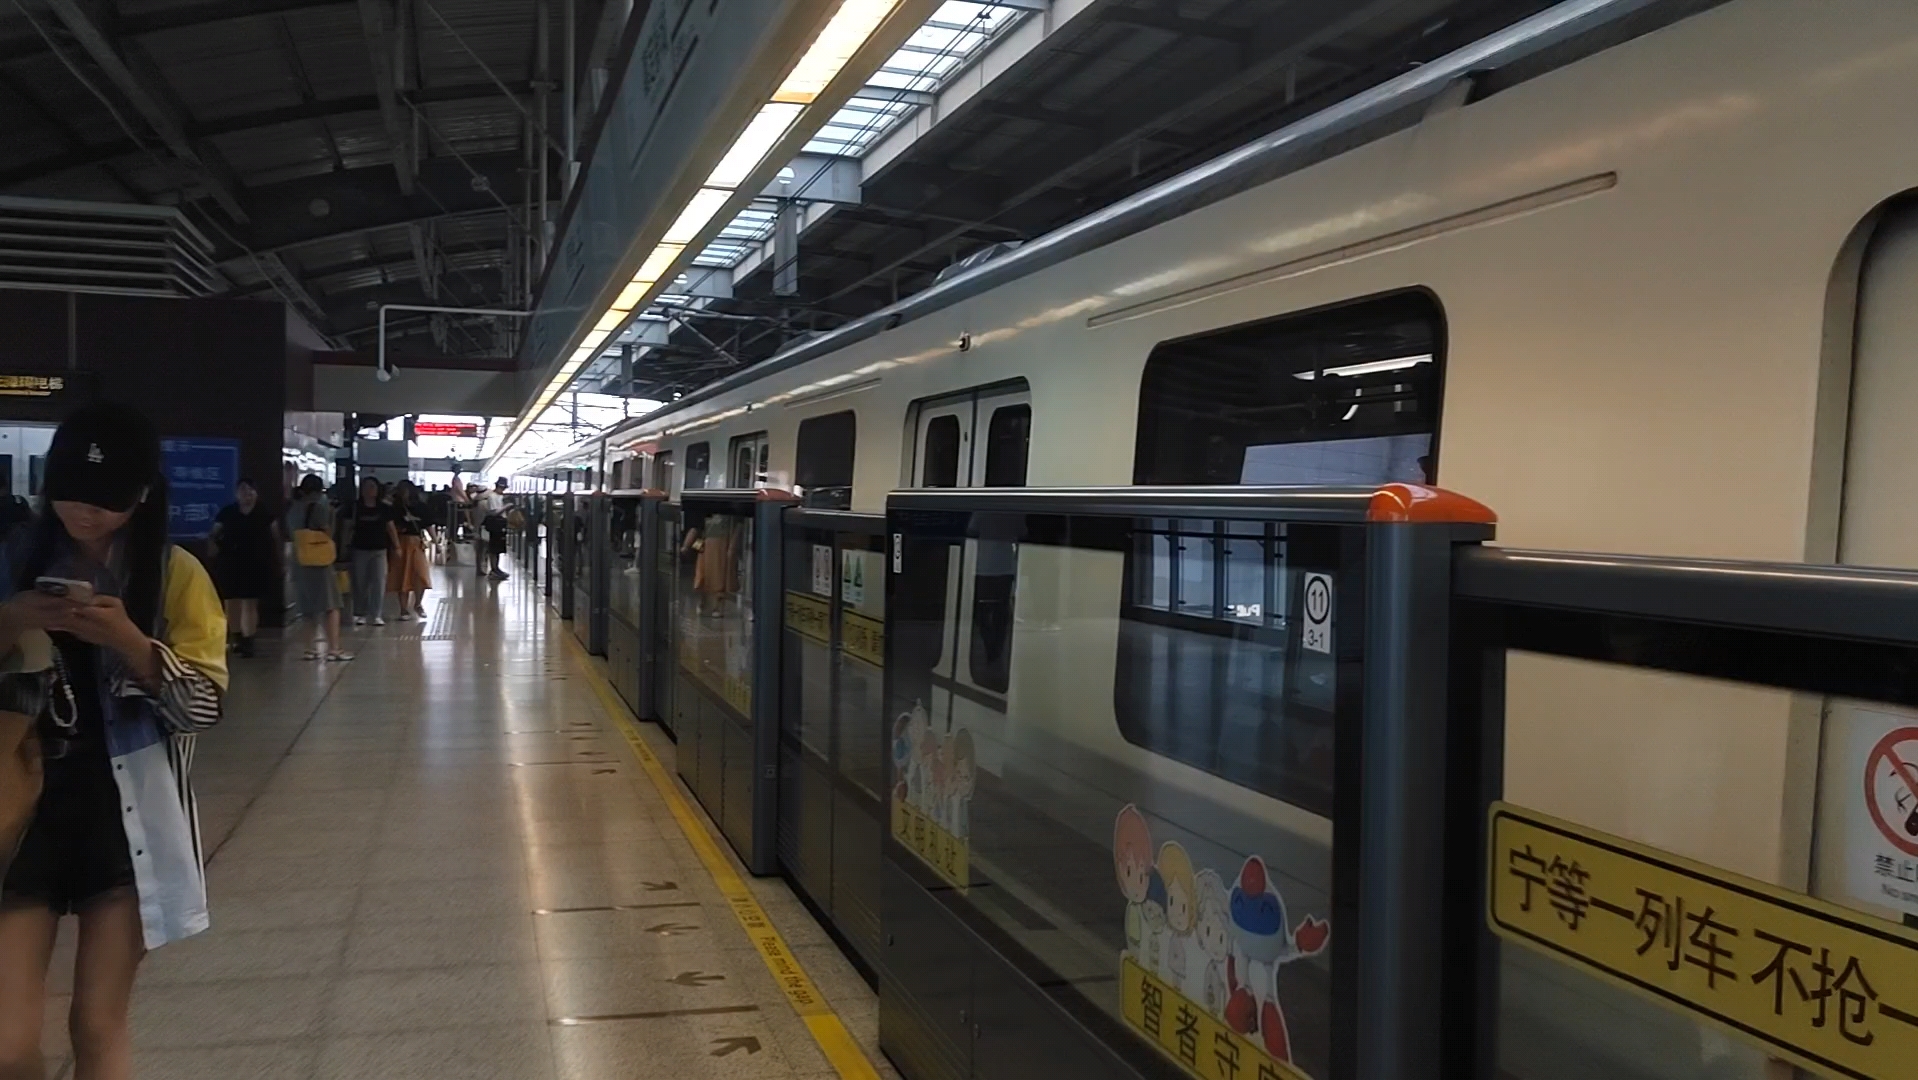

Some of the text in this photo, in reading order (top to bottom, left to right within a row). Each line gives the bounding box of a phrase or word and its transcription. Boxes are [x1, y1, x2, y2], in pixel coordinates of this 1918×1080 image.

[1312, 589, 1323, 612] 11
[1308, 629, 1324, 648] 3-1
[1874, 854, 1918, 883] 禁止
